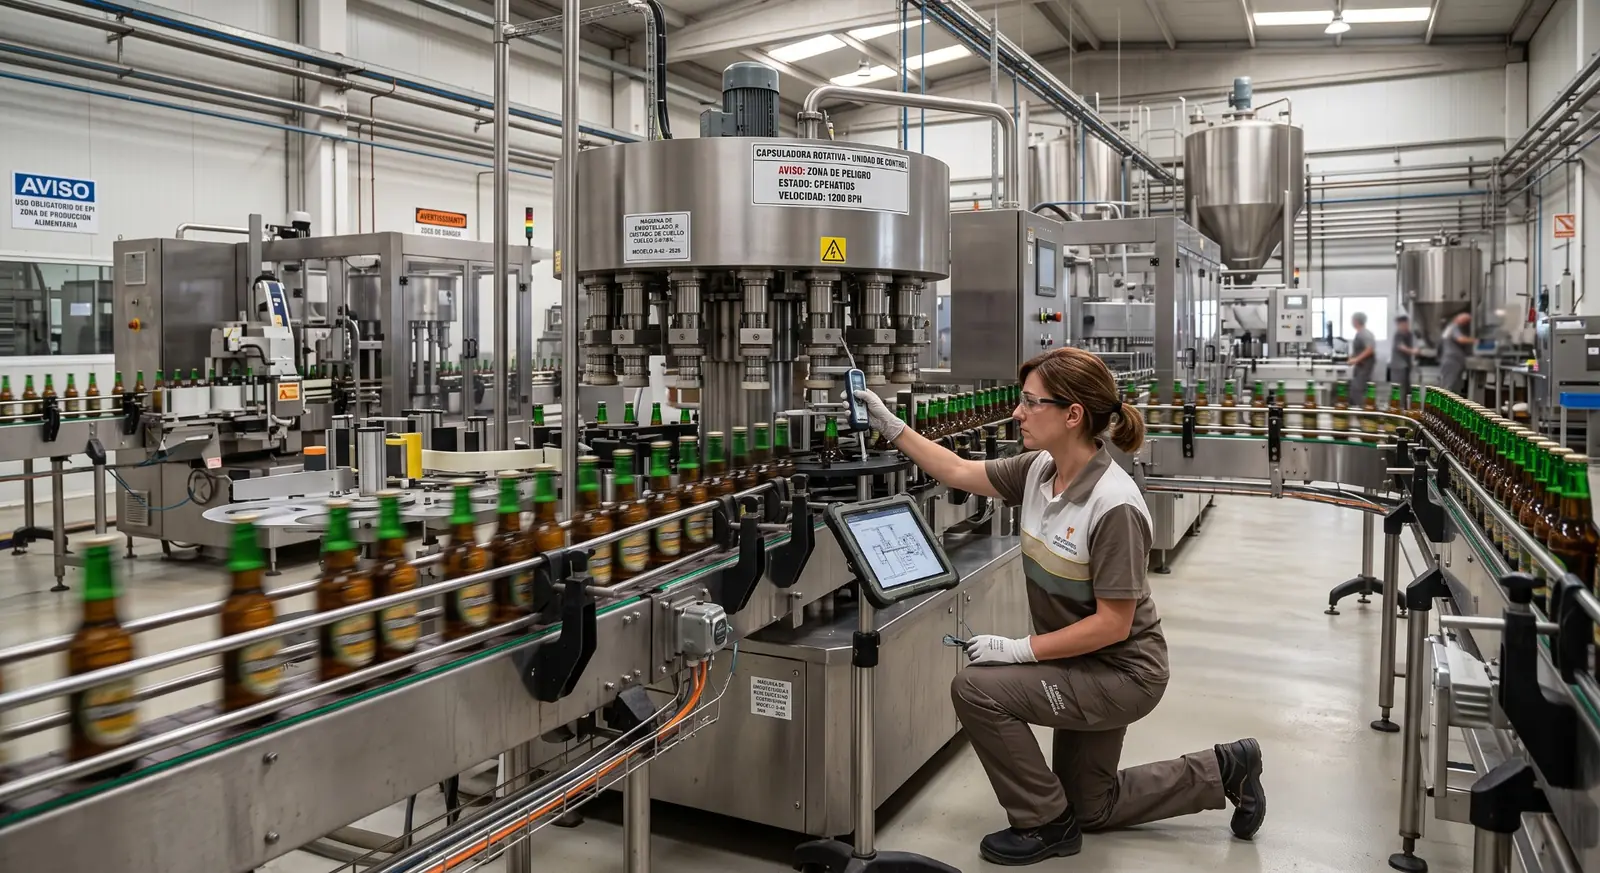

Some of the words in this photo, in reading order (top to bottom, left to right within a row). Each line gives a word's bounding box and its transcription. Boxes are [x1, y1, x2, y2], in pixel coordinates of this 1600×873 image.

[756, 149, 811, 159] CAPSULADORA
[813, 151, 846, 161] ROTATIVA
[877, 157, 884, 165] DE
[778, 166, 806, 175] AVISO:
[807, 167, 828, 176] ZONA
[830, 168, 840, 177] DE
[842, 169, 871, 180] PELIGRO
[20, 177, 90, 200] AVISO
[778, 178, 812, 188] ESTADO:
[778, 191, 826, 201] VELOCIDAD:
[828, 193, 846, 203] 1200
[847, 194, 862, 203] BPH
[20, 208, 38, 216] ZONA
[30, 200, 74, 211] OBLIGATORIO
[75, 204, 84, 212] DE
[34, 219, 78, 228] ALIMENTARIA
